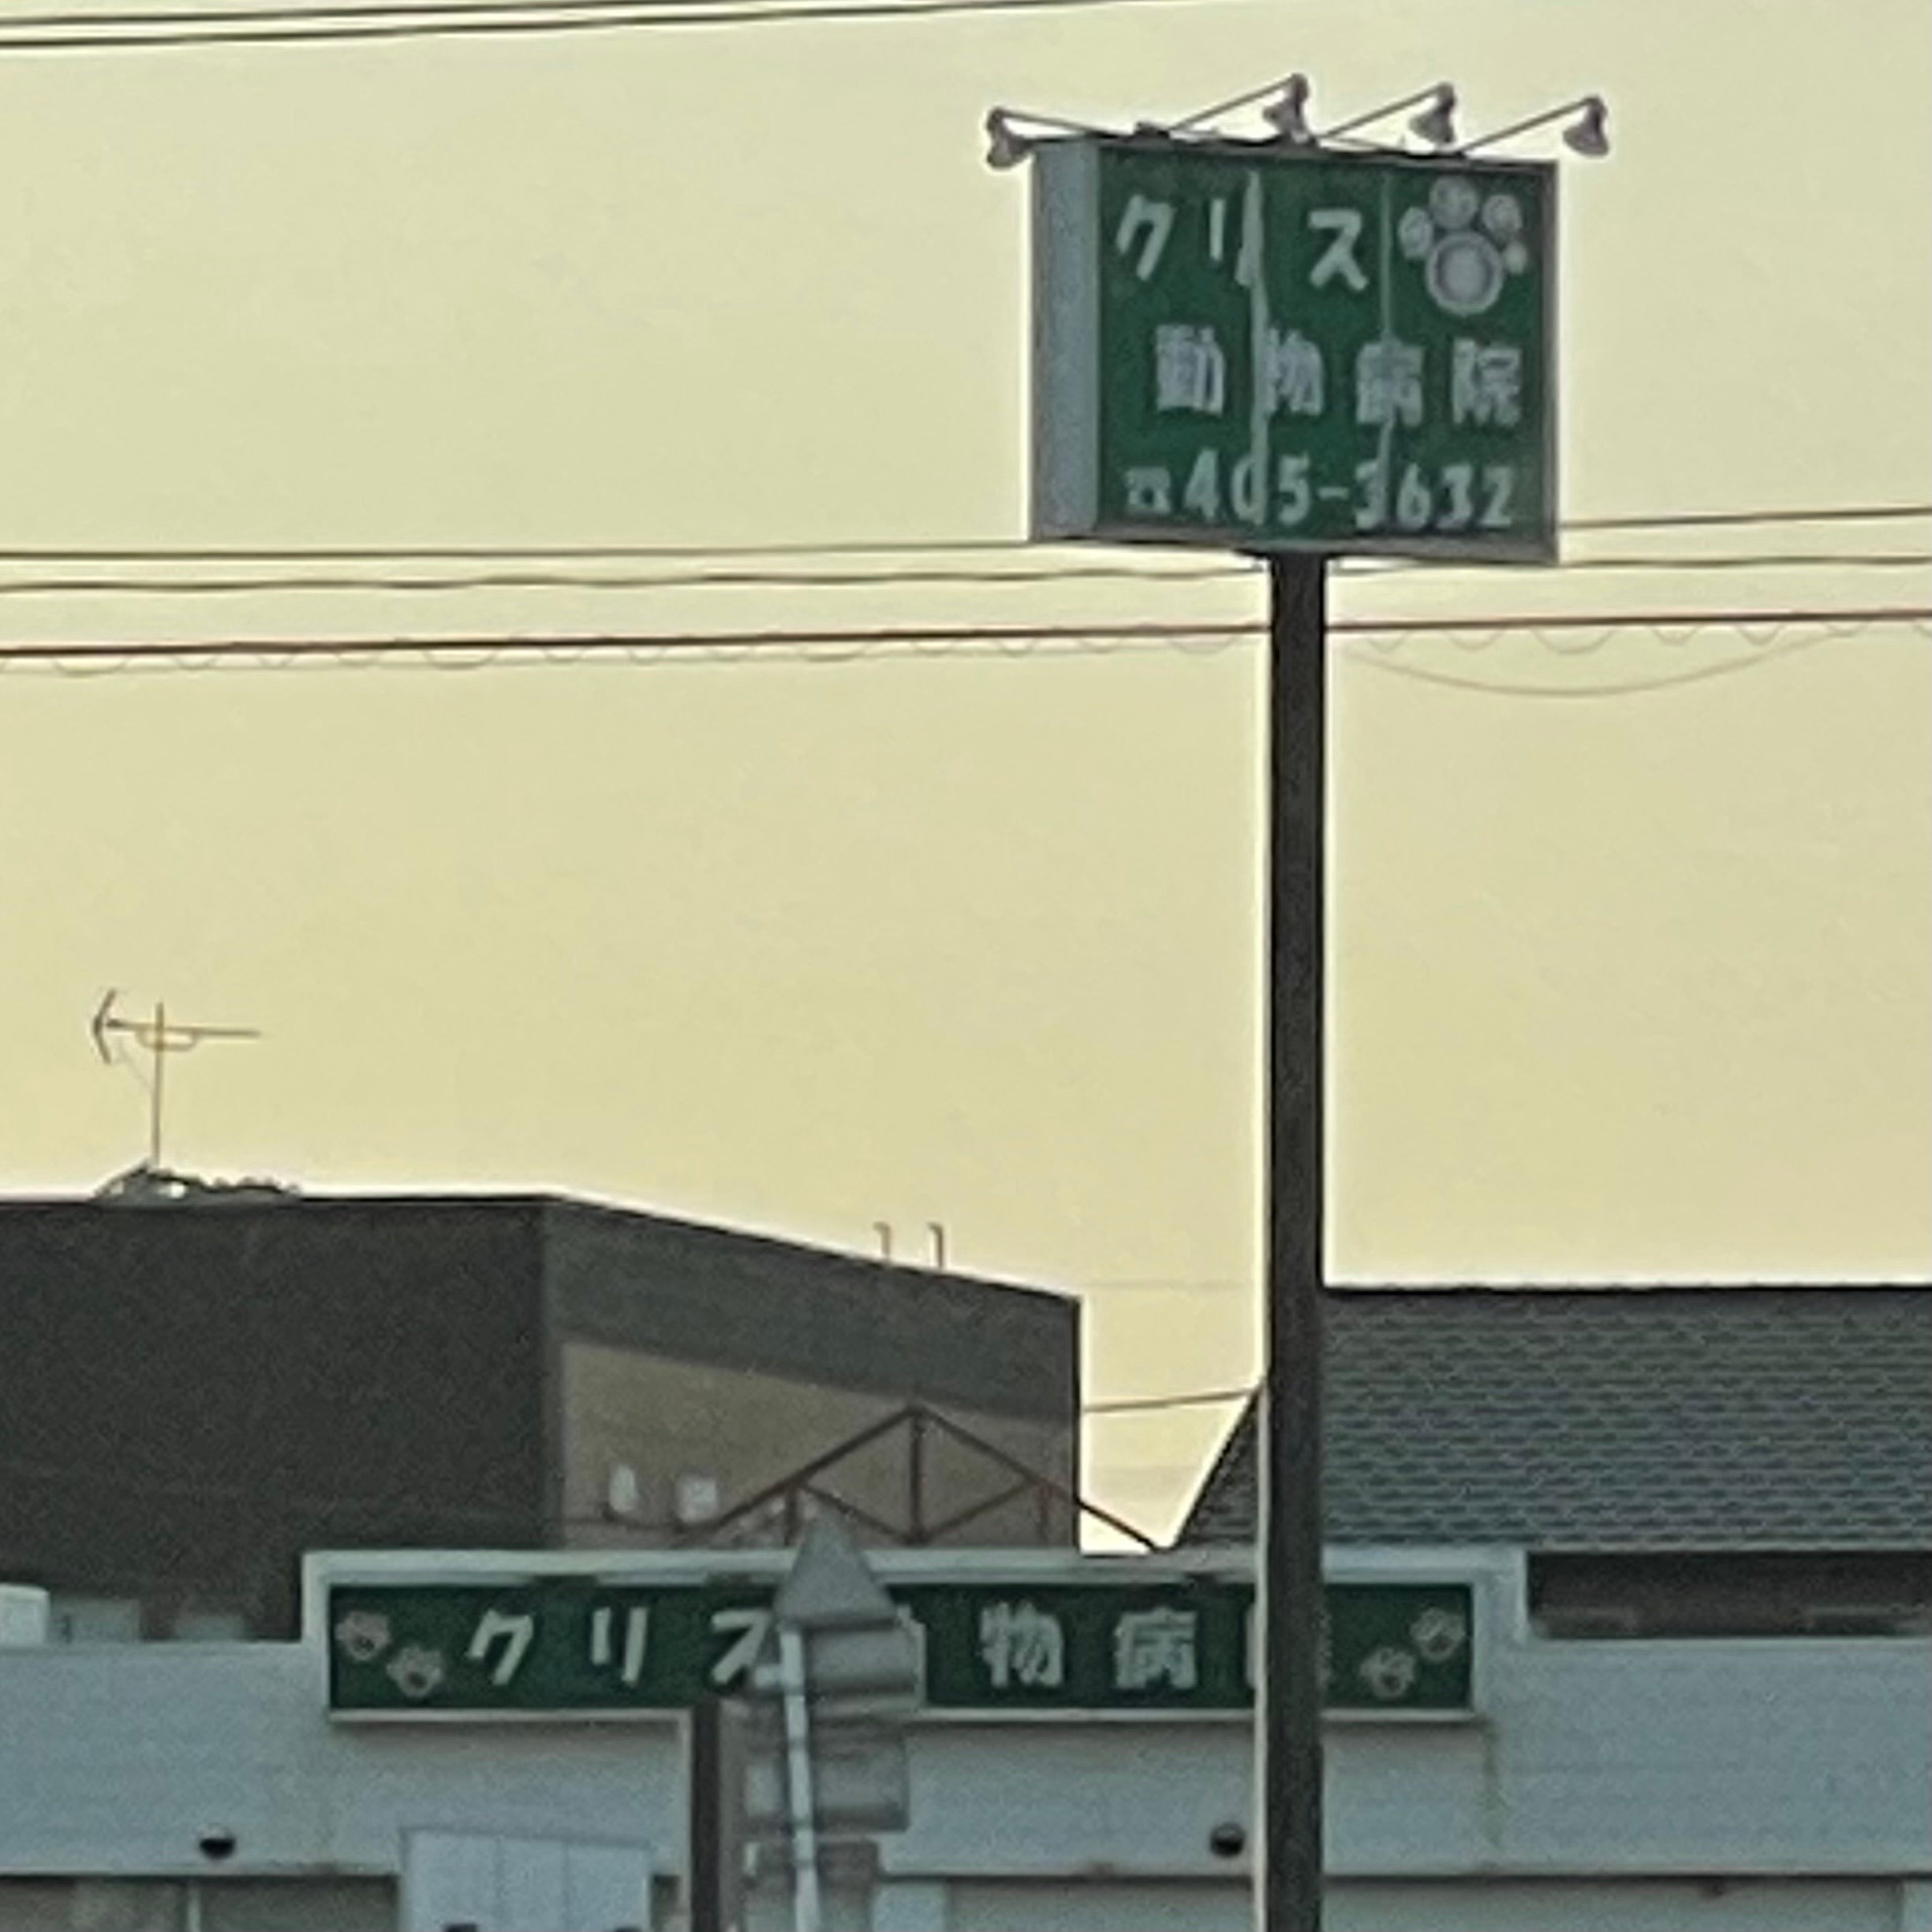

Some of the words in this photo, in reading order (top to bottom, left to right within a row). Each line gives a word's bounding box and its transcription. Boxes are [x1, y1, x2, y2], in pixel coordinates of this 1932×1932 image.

[1115, 194, 1369, 291] クリス
[1155, 323, 1522, 428] 動物病院
[465, 1601, 1332, 1690] クリス物病
